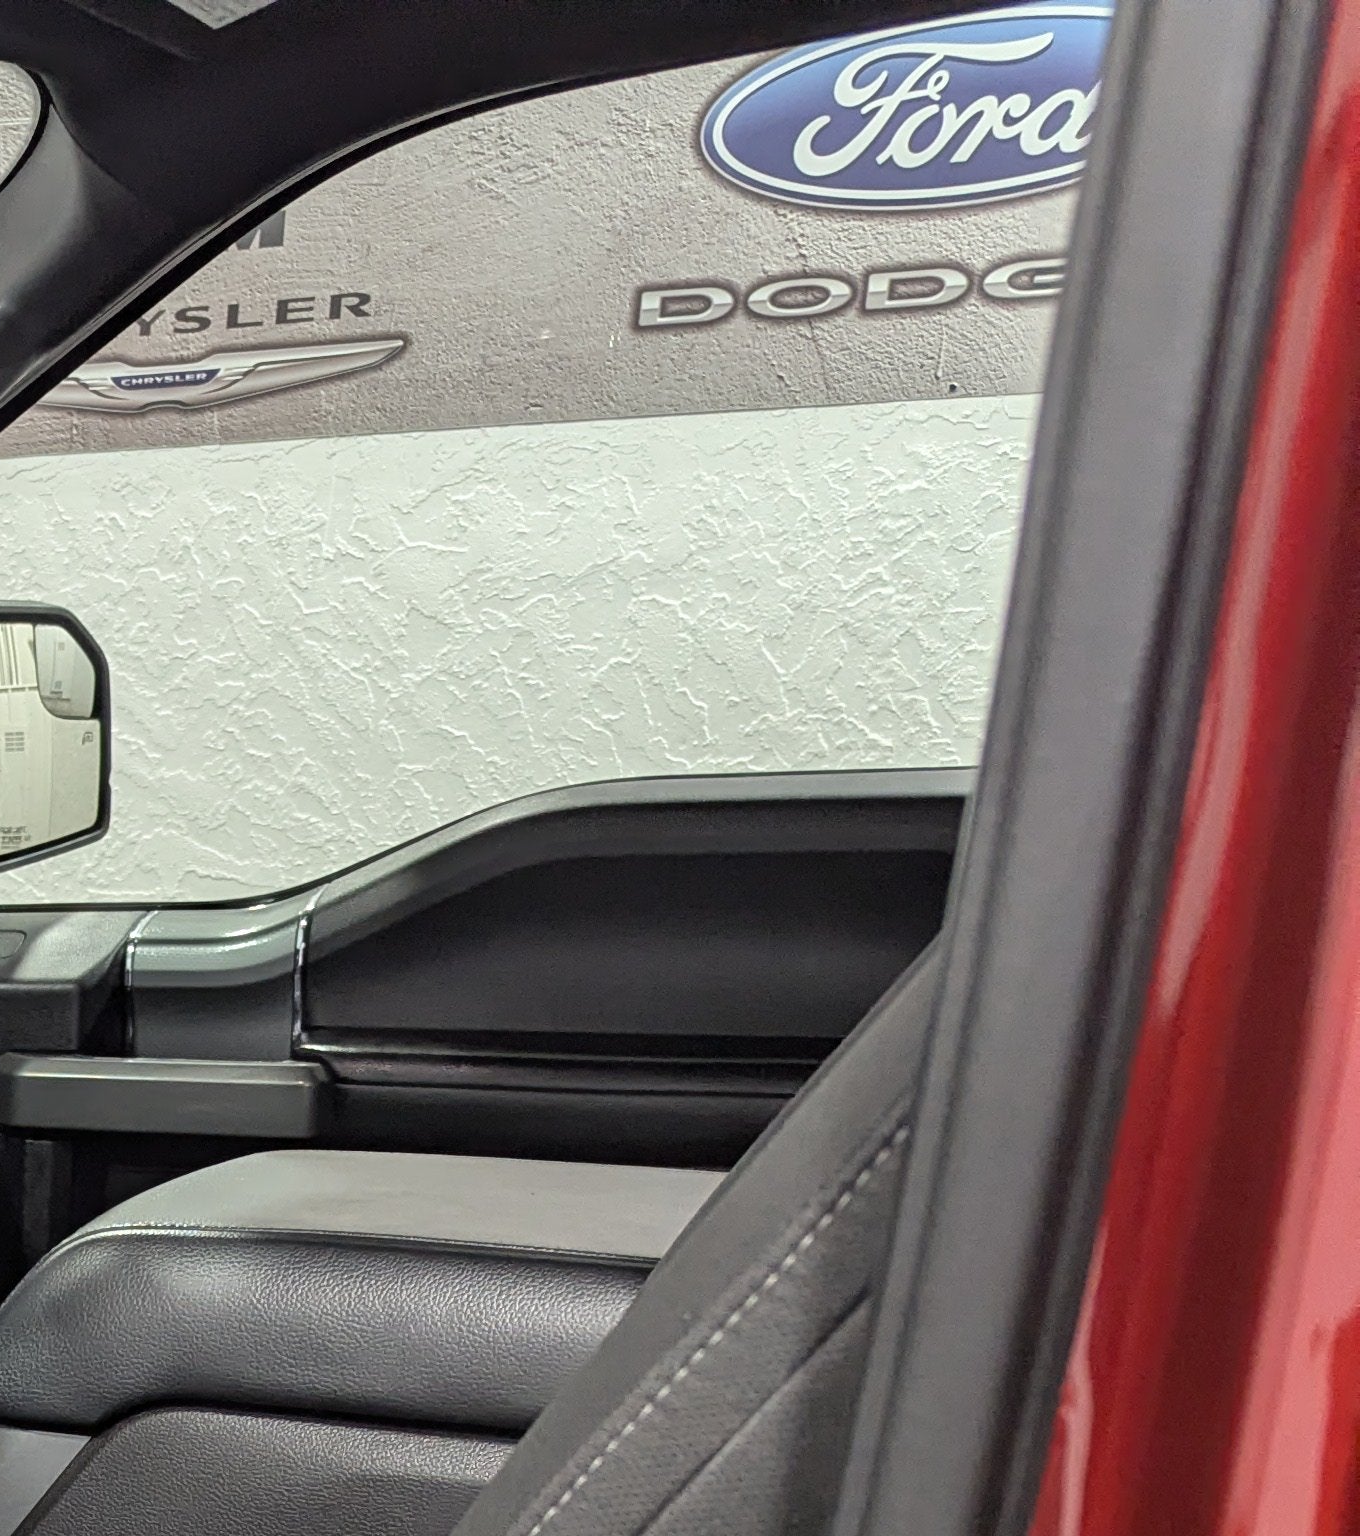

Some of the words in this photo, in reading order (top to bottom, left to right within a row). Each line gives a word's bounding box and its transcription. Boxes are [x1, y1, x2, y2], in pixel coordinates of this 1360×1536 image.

[135, 291, 372, 337] YSLER
[638, 257, 1068, 327] DODG
[120, 371, 208, 387] CHRYSLER
